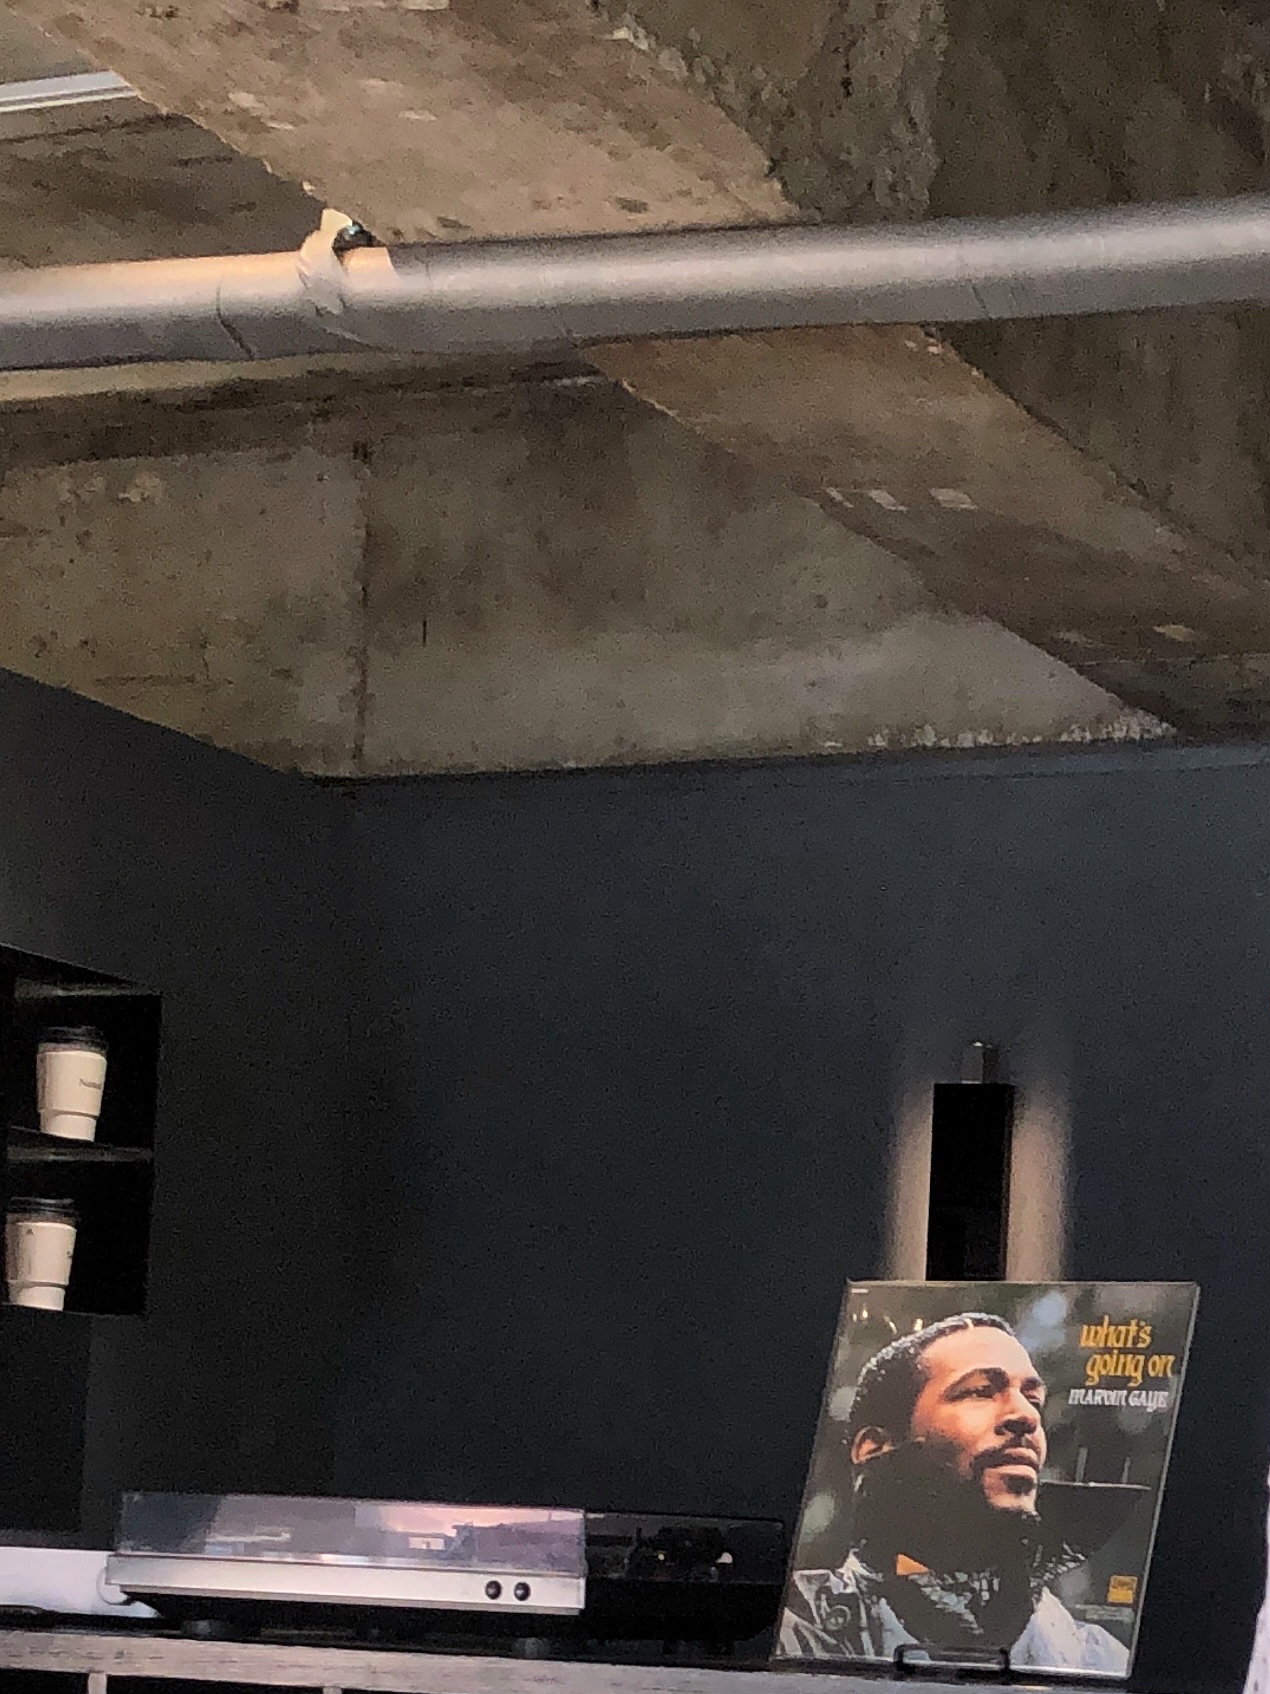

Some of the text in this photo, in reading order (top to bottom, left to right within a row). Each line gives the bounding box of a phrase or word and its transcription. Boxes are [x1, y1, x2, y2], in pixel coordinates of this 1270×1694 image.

[1080, 1314, 1152, 1348] what's
[1085, 1349, 1175, 1387] going on
